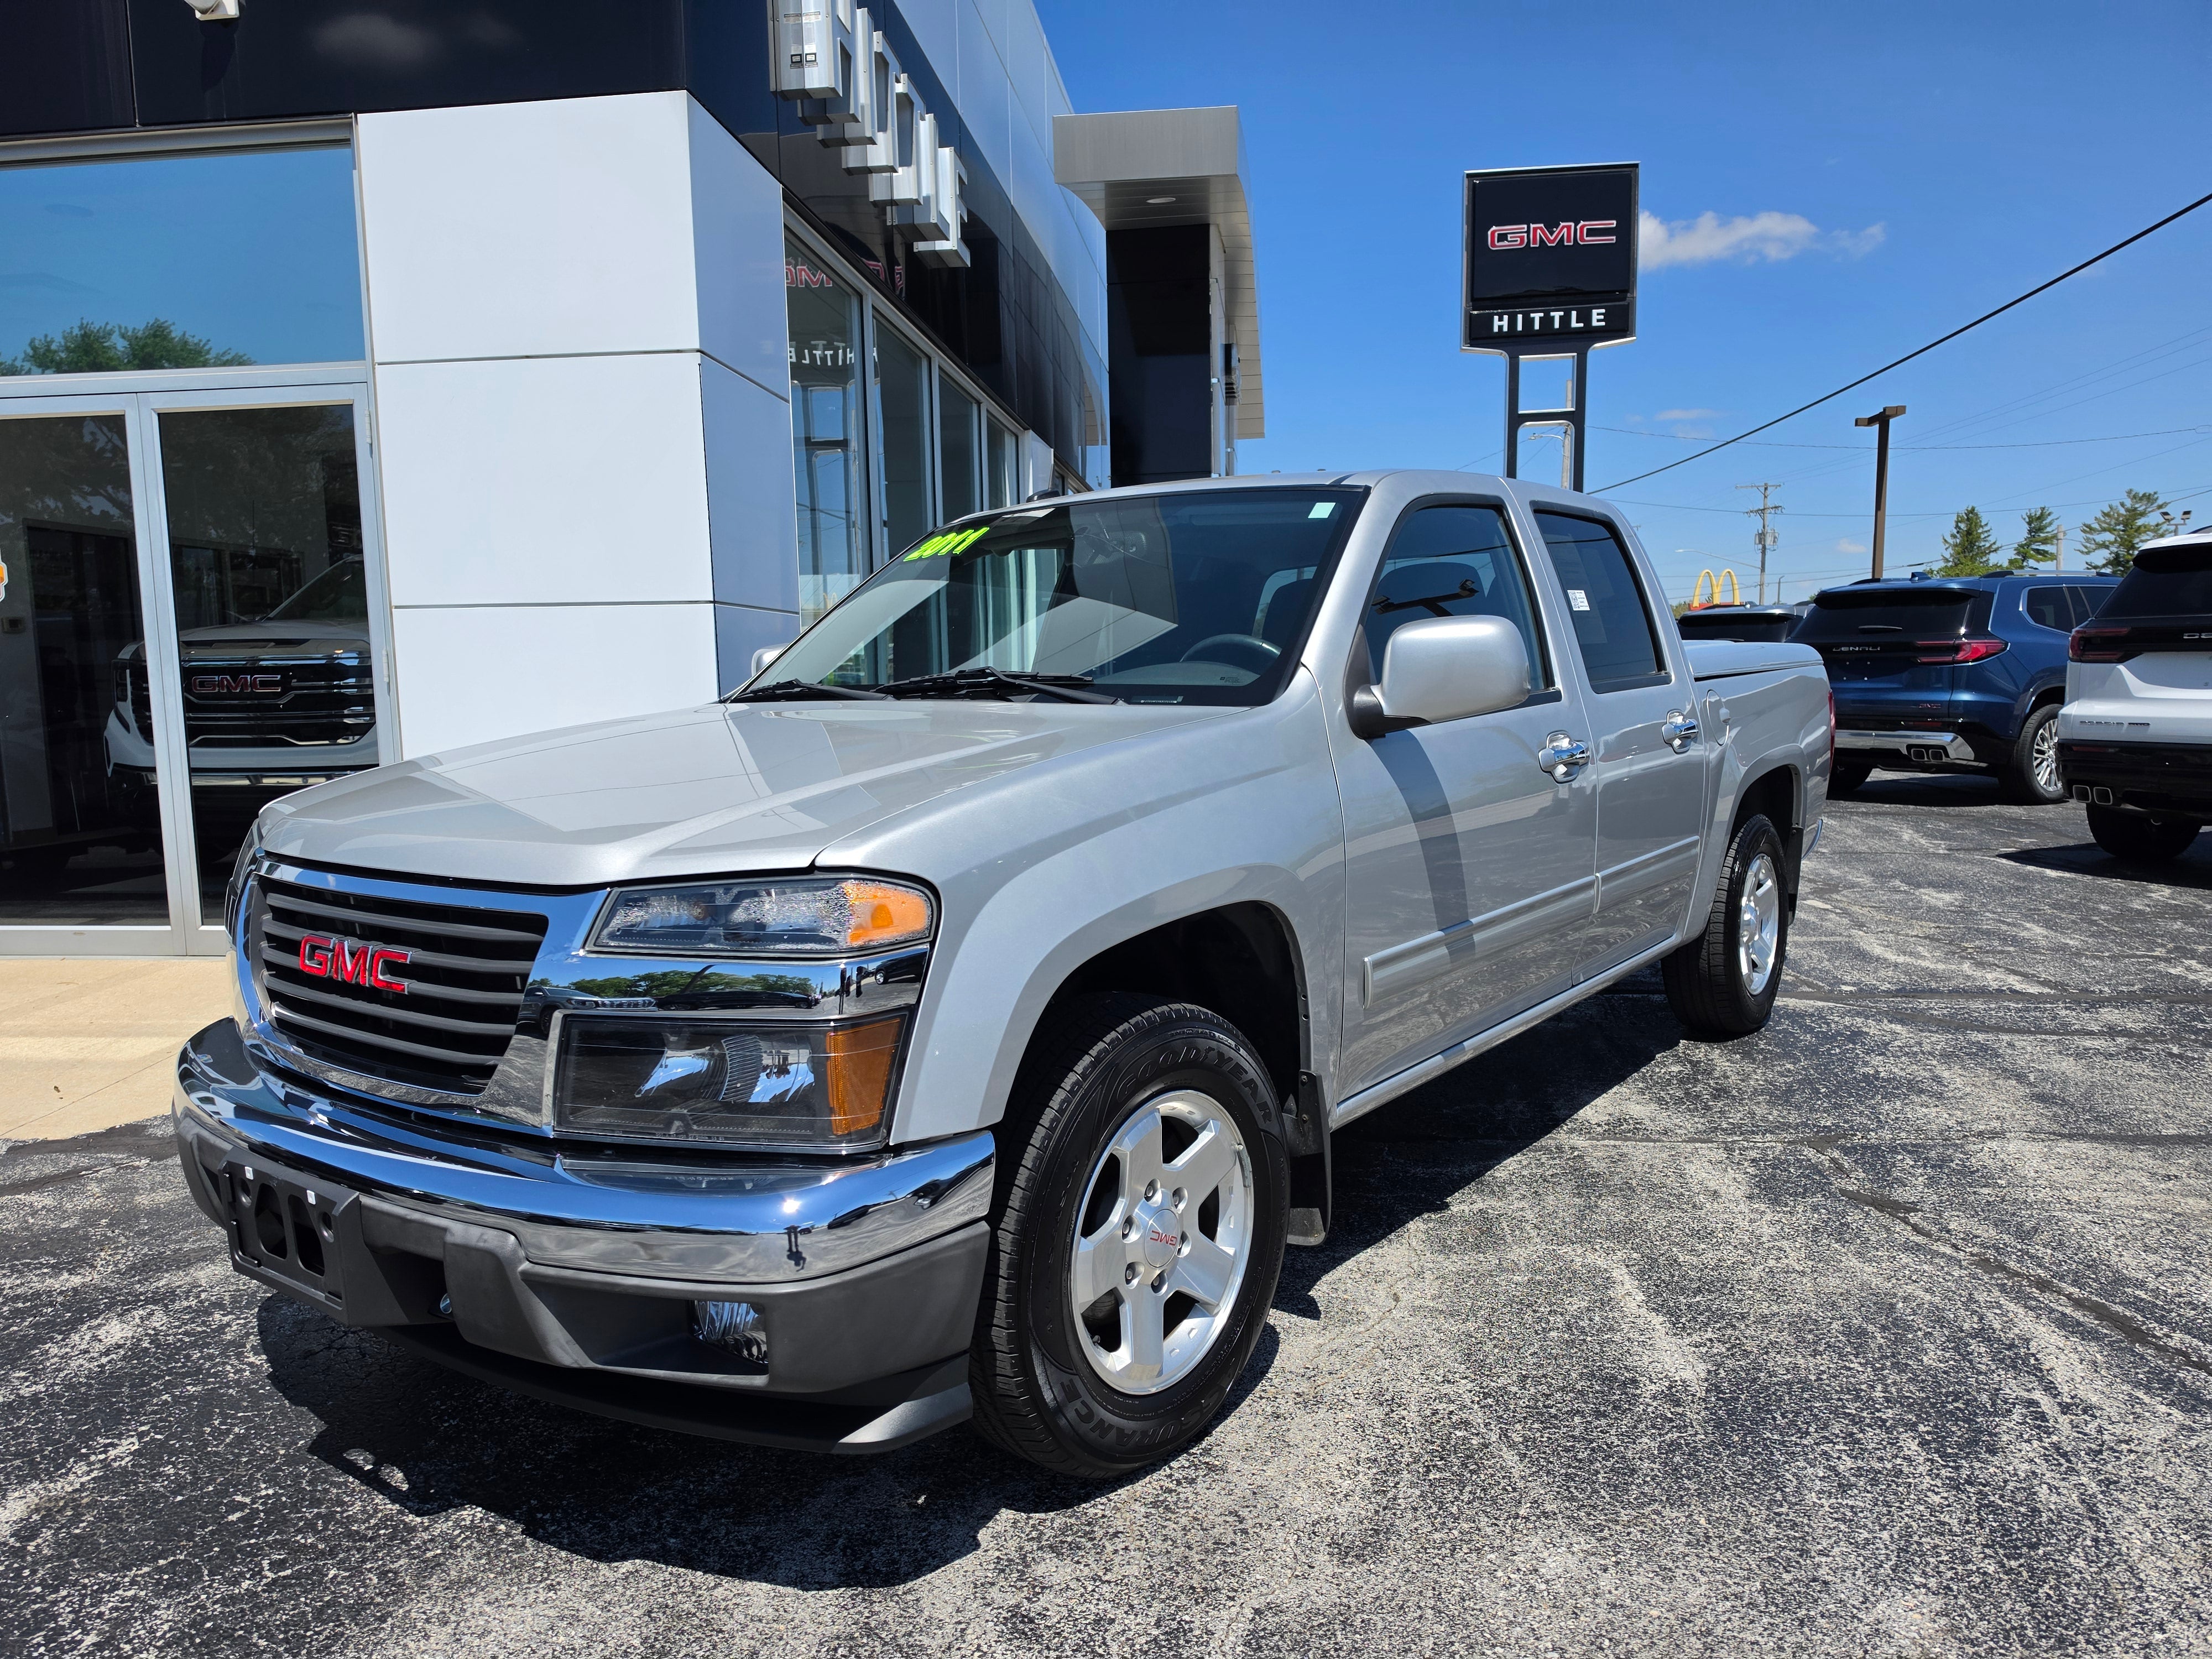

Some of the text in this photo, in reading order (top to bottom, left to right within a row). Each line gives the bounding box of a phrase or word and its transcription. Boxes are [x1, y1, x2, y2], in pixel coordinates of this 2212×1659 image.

[1488, 220, 1616, 250] GMC
[1494, 309, 1606, 333] HITTLE
[903, 527, 990, 562] 2011
[192, 675, 281, 693] GMC
[299, 933, 414, 994] GMC
[1150, 1229, 1178, 1246] GMC
